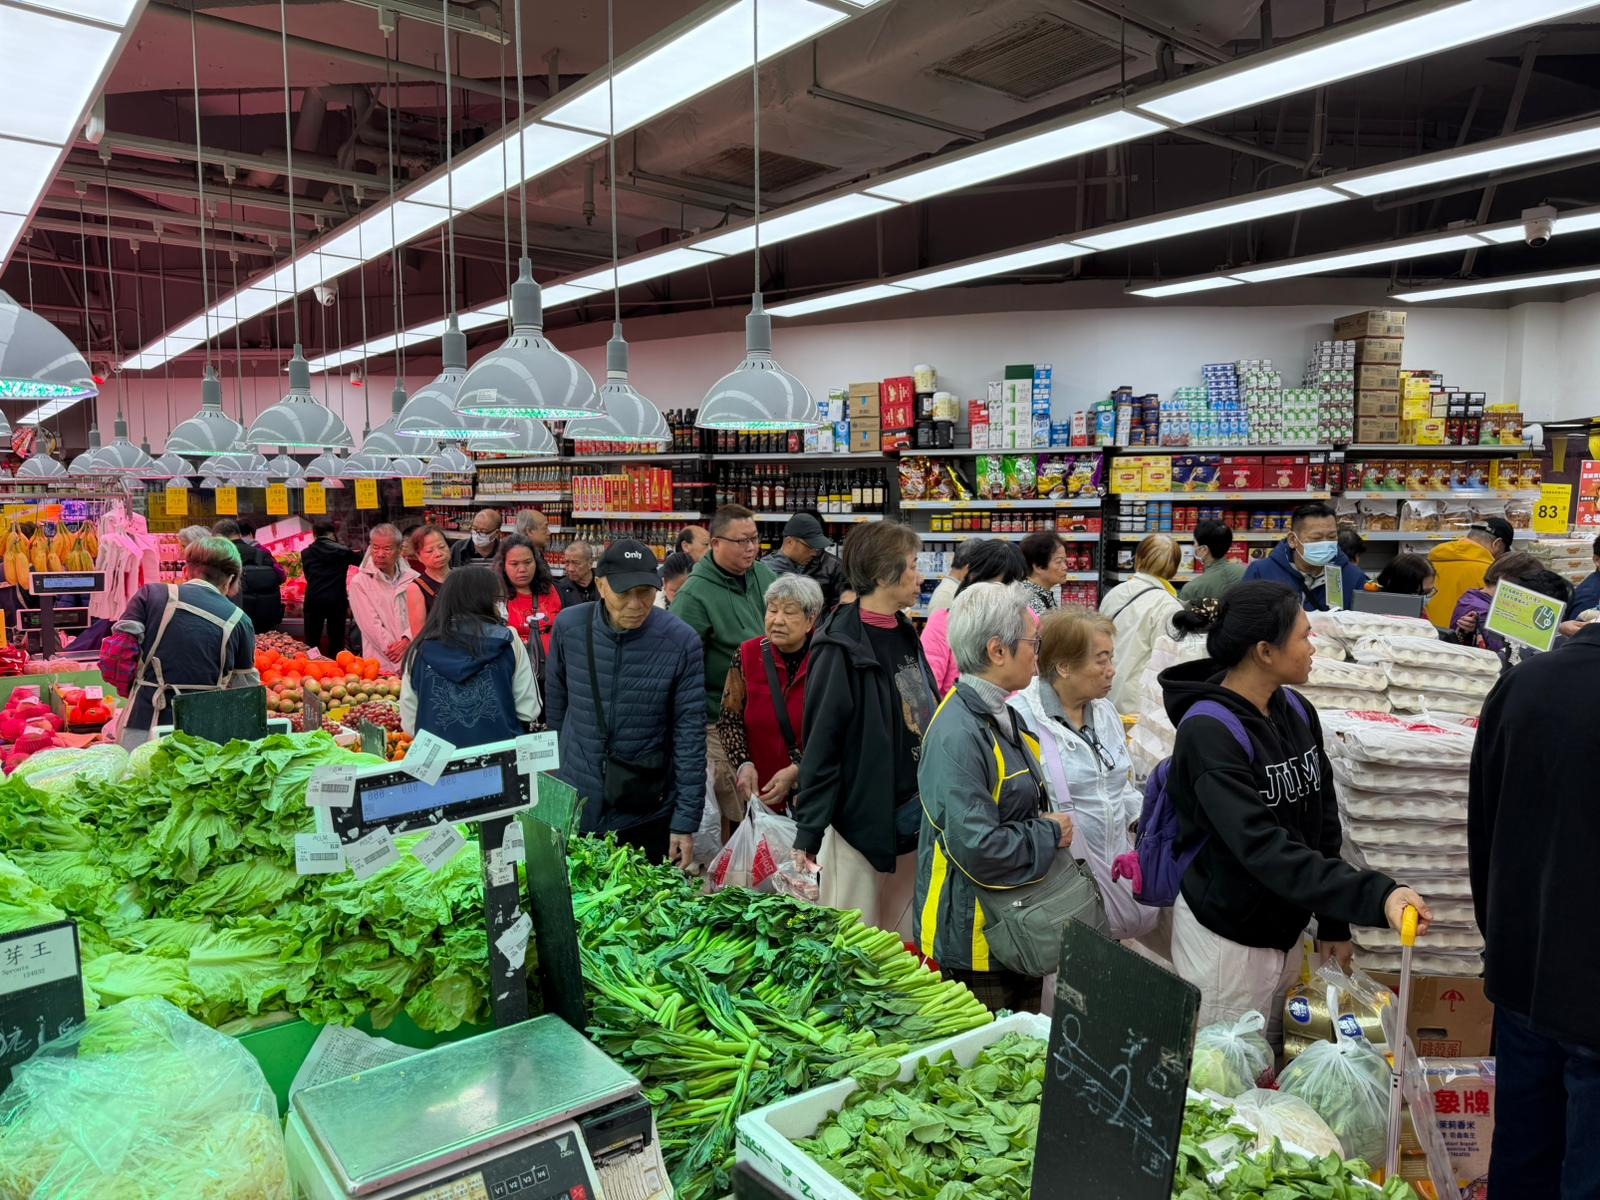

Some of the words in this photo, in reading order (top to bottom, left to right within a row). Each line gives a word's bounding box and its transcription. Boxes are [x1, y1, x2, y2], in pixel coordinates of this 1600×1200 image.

[1538, 505, 1558, 519] 83
[623, 550, 643, 560] Only
[4, 941, 52, 966] 芽王
[1433, 1088, 1490, 1115] 象牌
[495, 1186, 504, 1194] V1
[508, 1180, 518, 1189] V2
[522, 1175, 532, 1184] V3
[537, 1170, 546, 1179] V4
